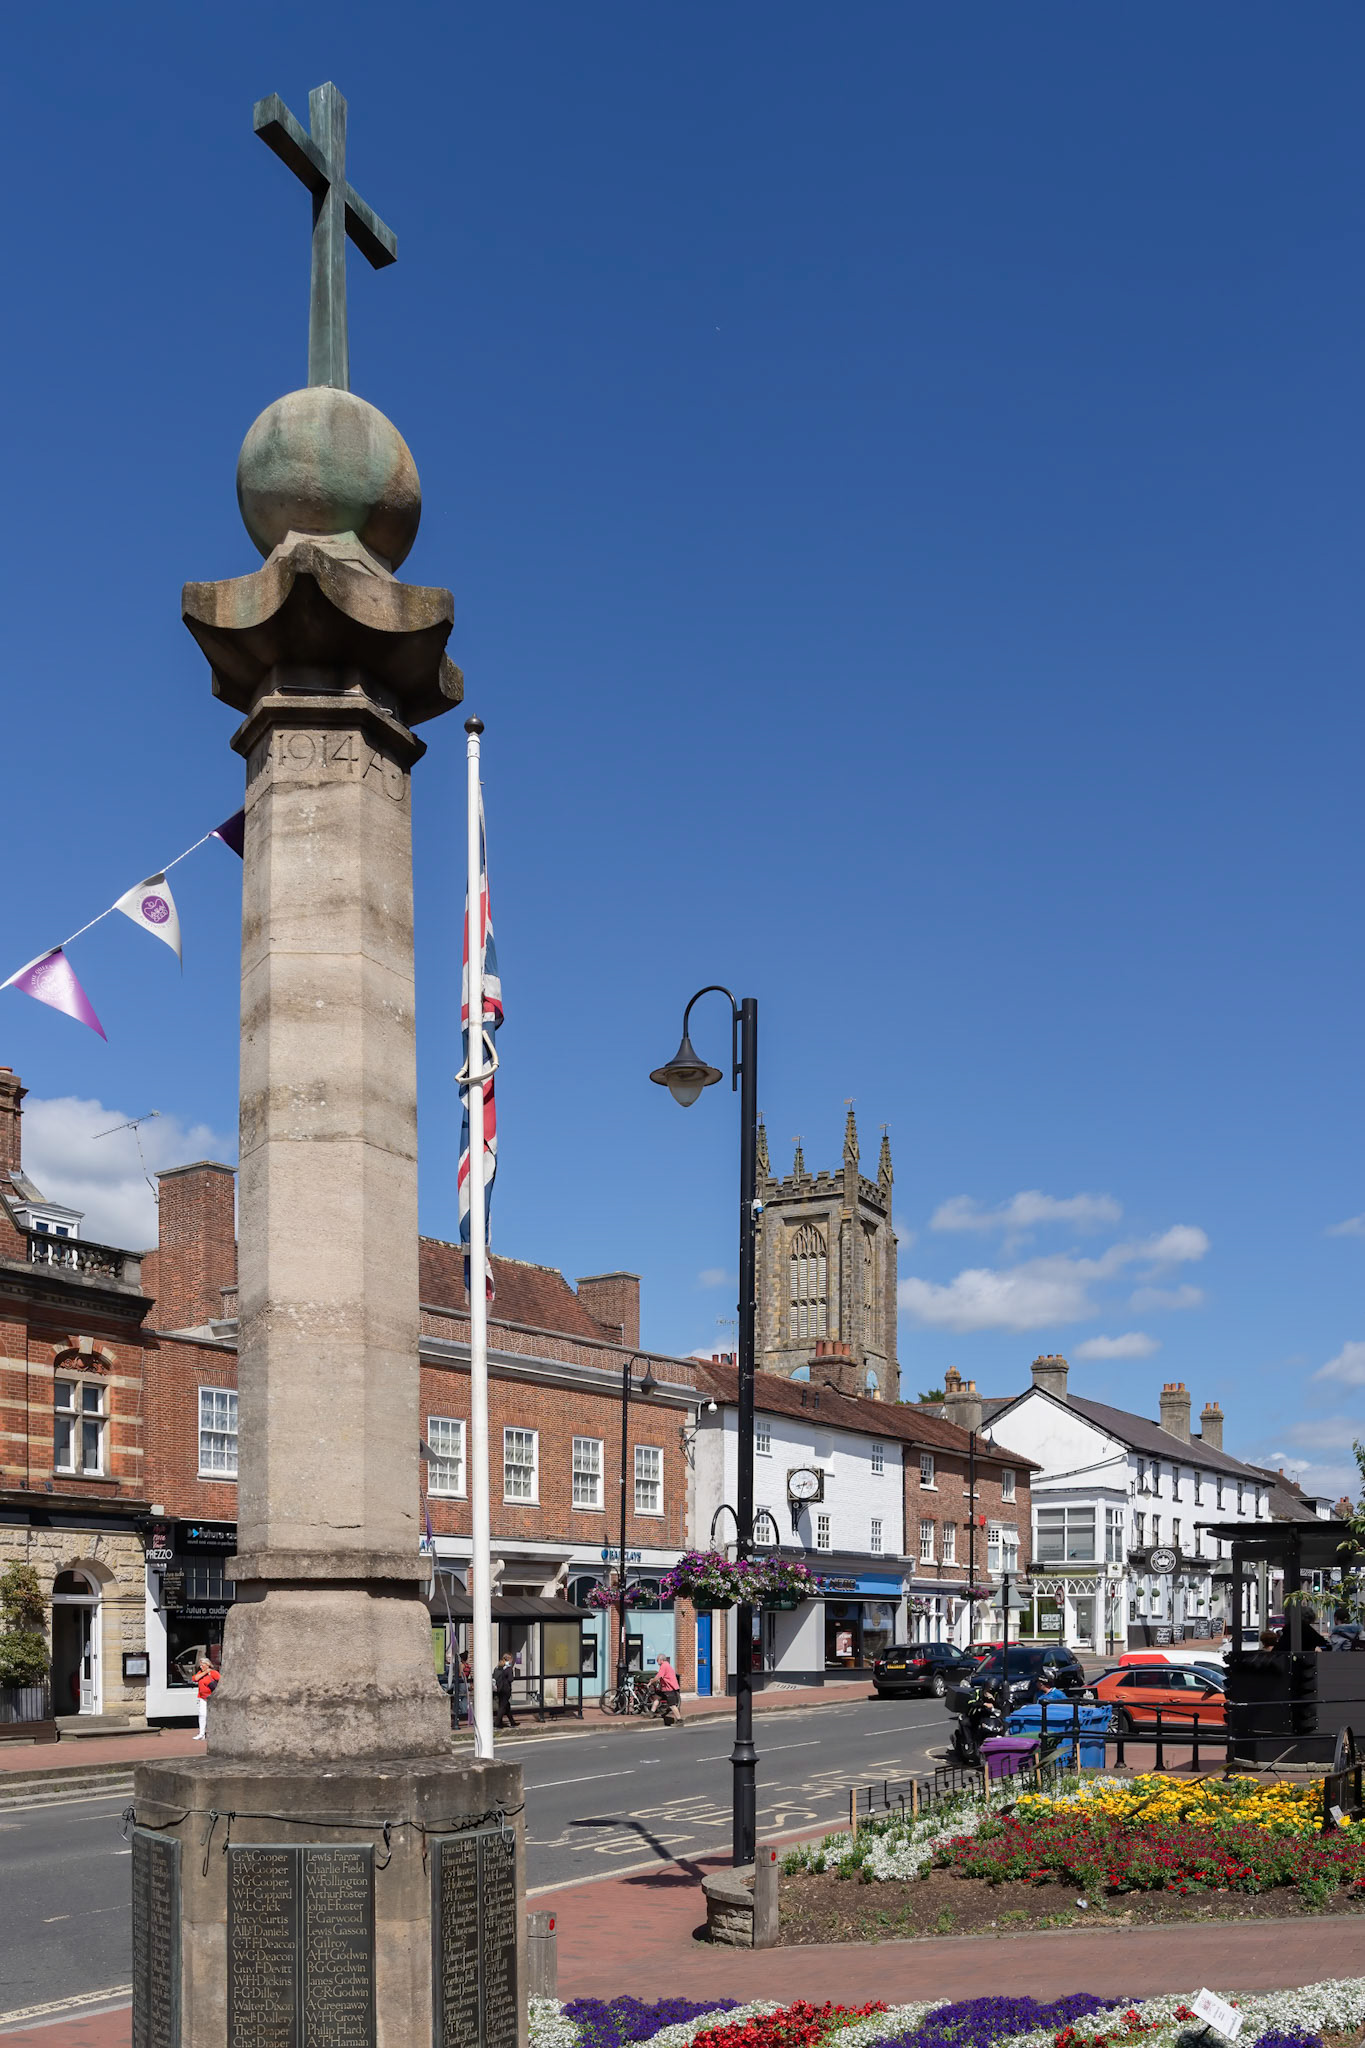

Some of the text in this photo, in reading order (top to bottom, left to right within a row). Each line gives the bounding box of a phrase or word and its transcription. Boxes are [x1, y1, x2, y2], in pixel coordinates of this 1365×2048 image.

[278, 734, 359, 774] 1914
[146, 1549, 173, 1560] PREZZO
[186, 1604, 228, 1614] future audio
[307, 1850, 360, 1861] Lewis Farrar
[306, 1862, 364, 1873] Charlie Field
[306, 1886, 367, 1898] Arthur Foster
[306, 1899, 326, 1913] John
[307, 1924, 367, 1935] Lewis Gasson
[306, 1973, 368, 1988] James Godwin
[233, 1999, 293, 2010] Walter Dixon
[257, 2012, 294, 2026] Dollery
[257, 2024, 290, 2038] Draper
[307, 2023, 367, 2038] Philip Hardy
